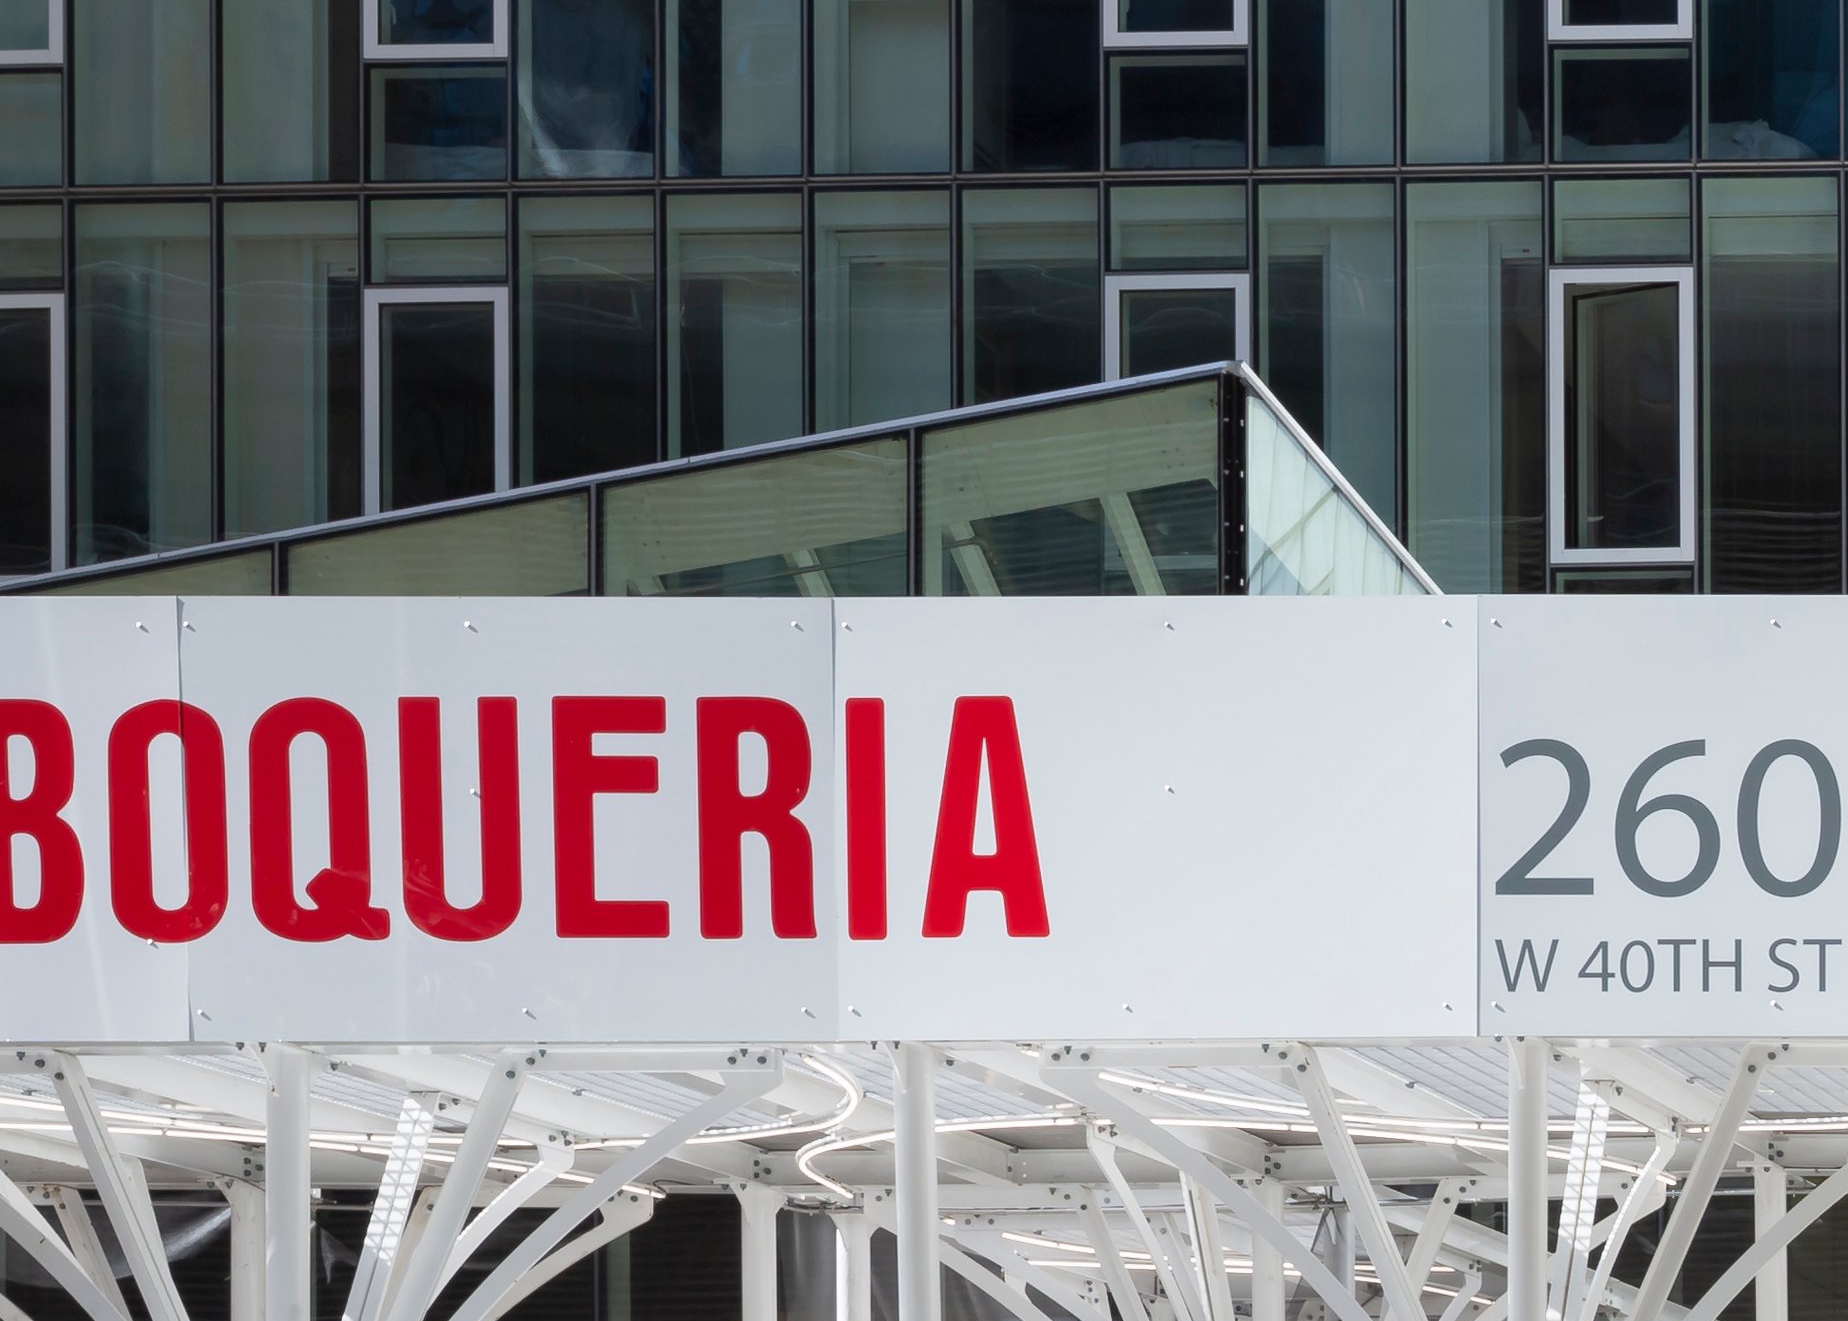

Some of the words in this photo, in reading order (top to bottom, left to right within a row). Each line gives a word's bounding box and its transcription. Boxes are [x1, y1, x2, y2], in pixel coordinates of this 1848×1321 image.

[0, 697, 1049, 943] BOQUERIA
[1496, 739, 1841, 897] 260
[1495, 940, 1558, 992] W
[1579, 939, 1741, 992] 40TH
[1768, 939, 1841, 992] ST
